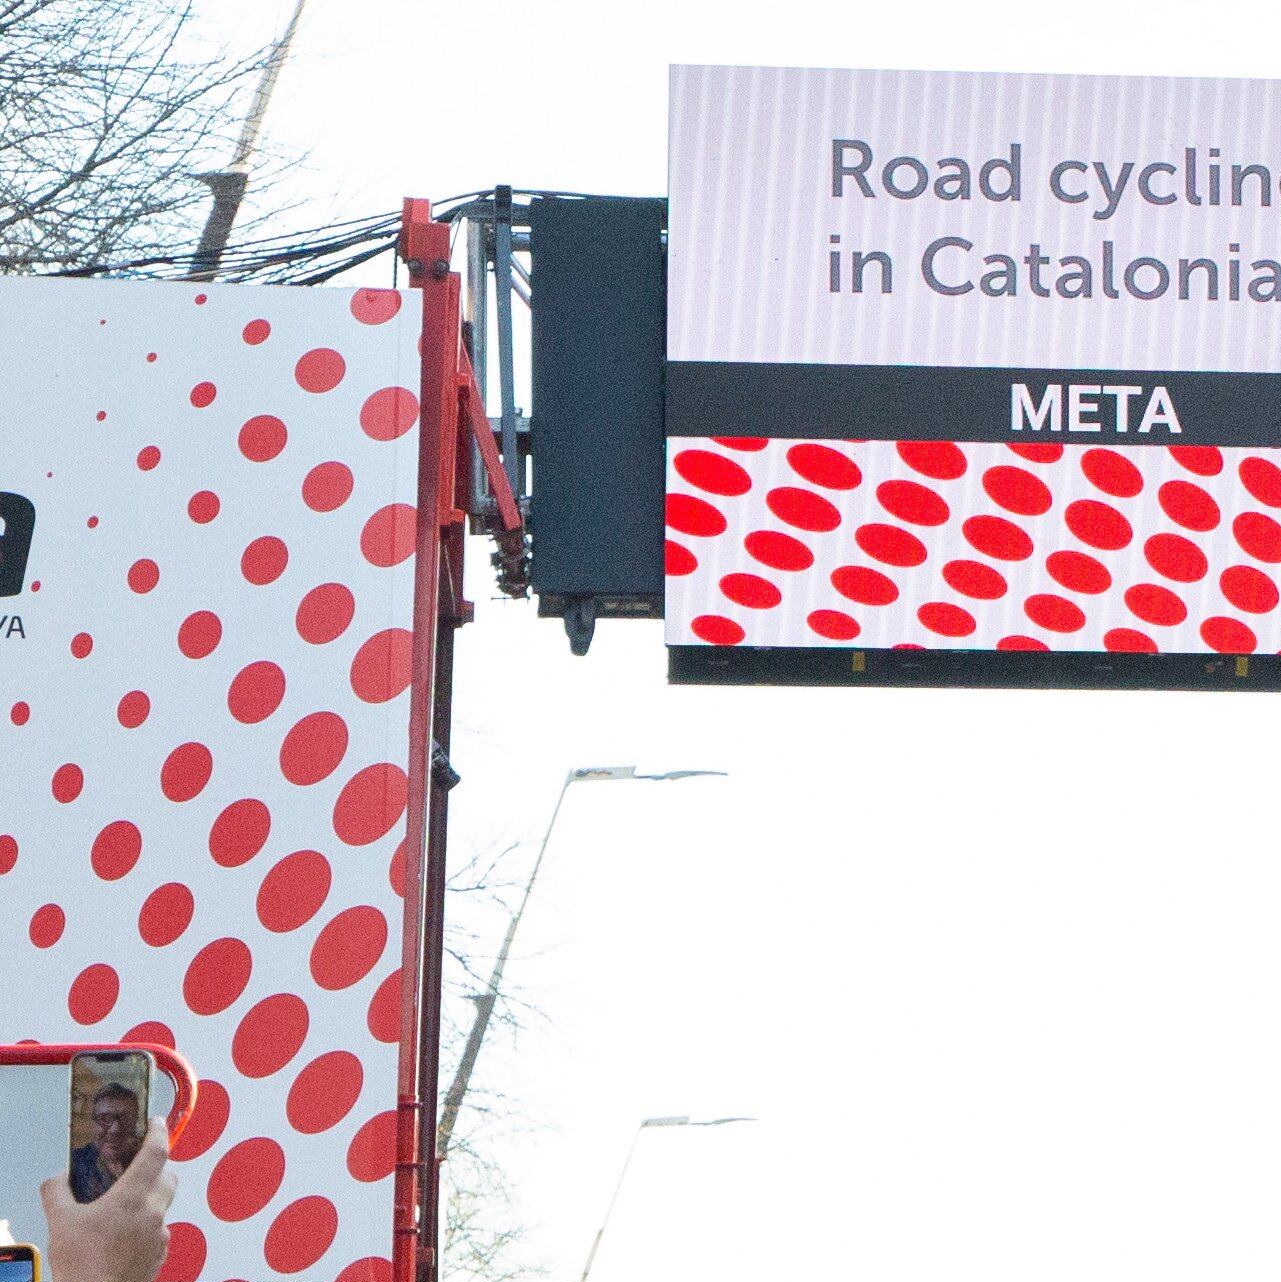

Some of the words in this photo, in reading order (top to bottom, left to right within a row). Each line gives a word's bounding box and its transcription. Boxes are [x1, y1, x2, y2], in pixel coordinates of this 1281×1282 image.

[831, 138, 1021, 202] Road
[828, 235, 893, 295] in
[1011, 384, 1182, 434] META
